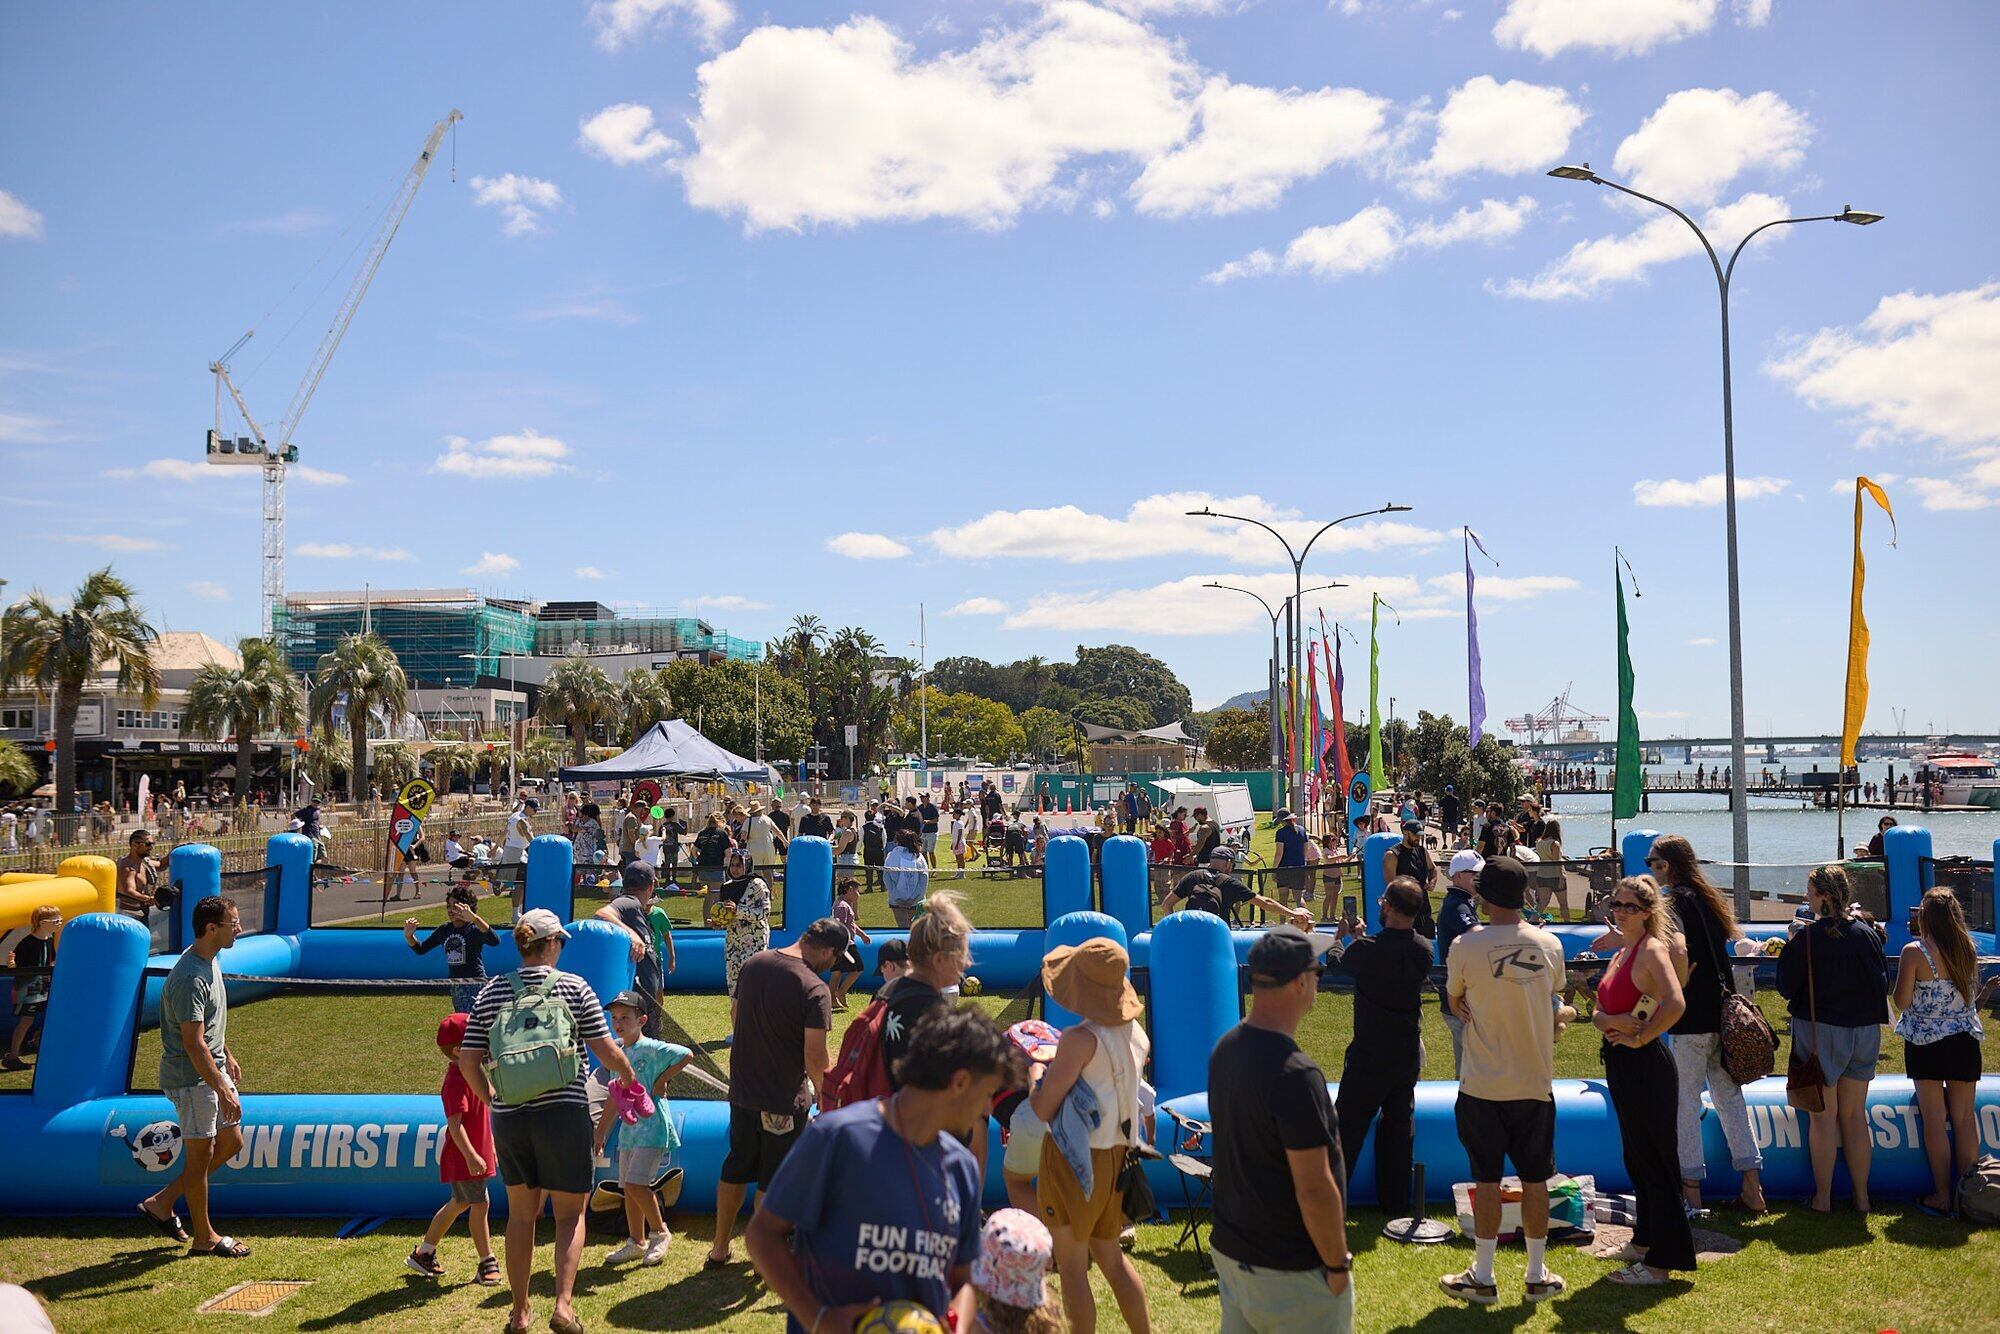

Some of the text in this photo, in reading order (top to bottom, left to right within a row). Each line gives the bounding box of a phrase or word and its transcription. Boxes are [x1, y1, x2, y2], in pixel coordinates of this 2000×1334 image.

[189, 743, 200, 752] THE
[201, 743, 222, 752] CROWN
[228, 743, 239, 752] BAD
[1746, 1104, 1802, 1149] UN
[225, 1124, 283, 1170] UN
[290, 1123, 408, 1169] FIRST
[858, 1223, 958, 1260] FUN FIRST
[855, 1246, 947, 1282] FOOTBA
